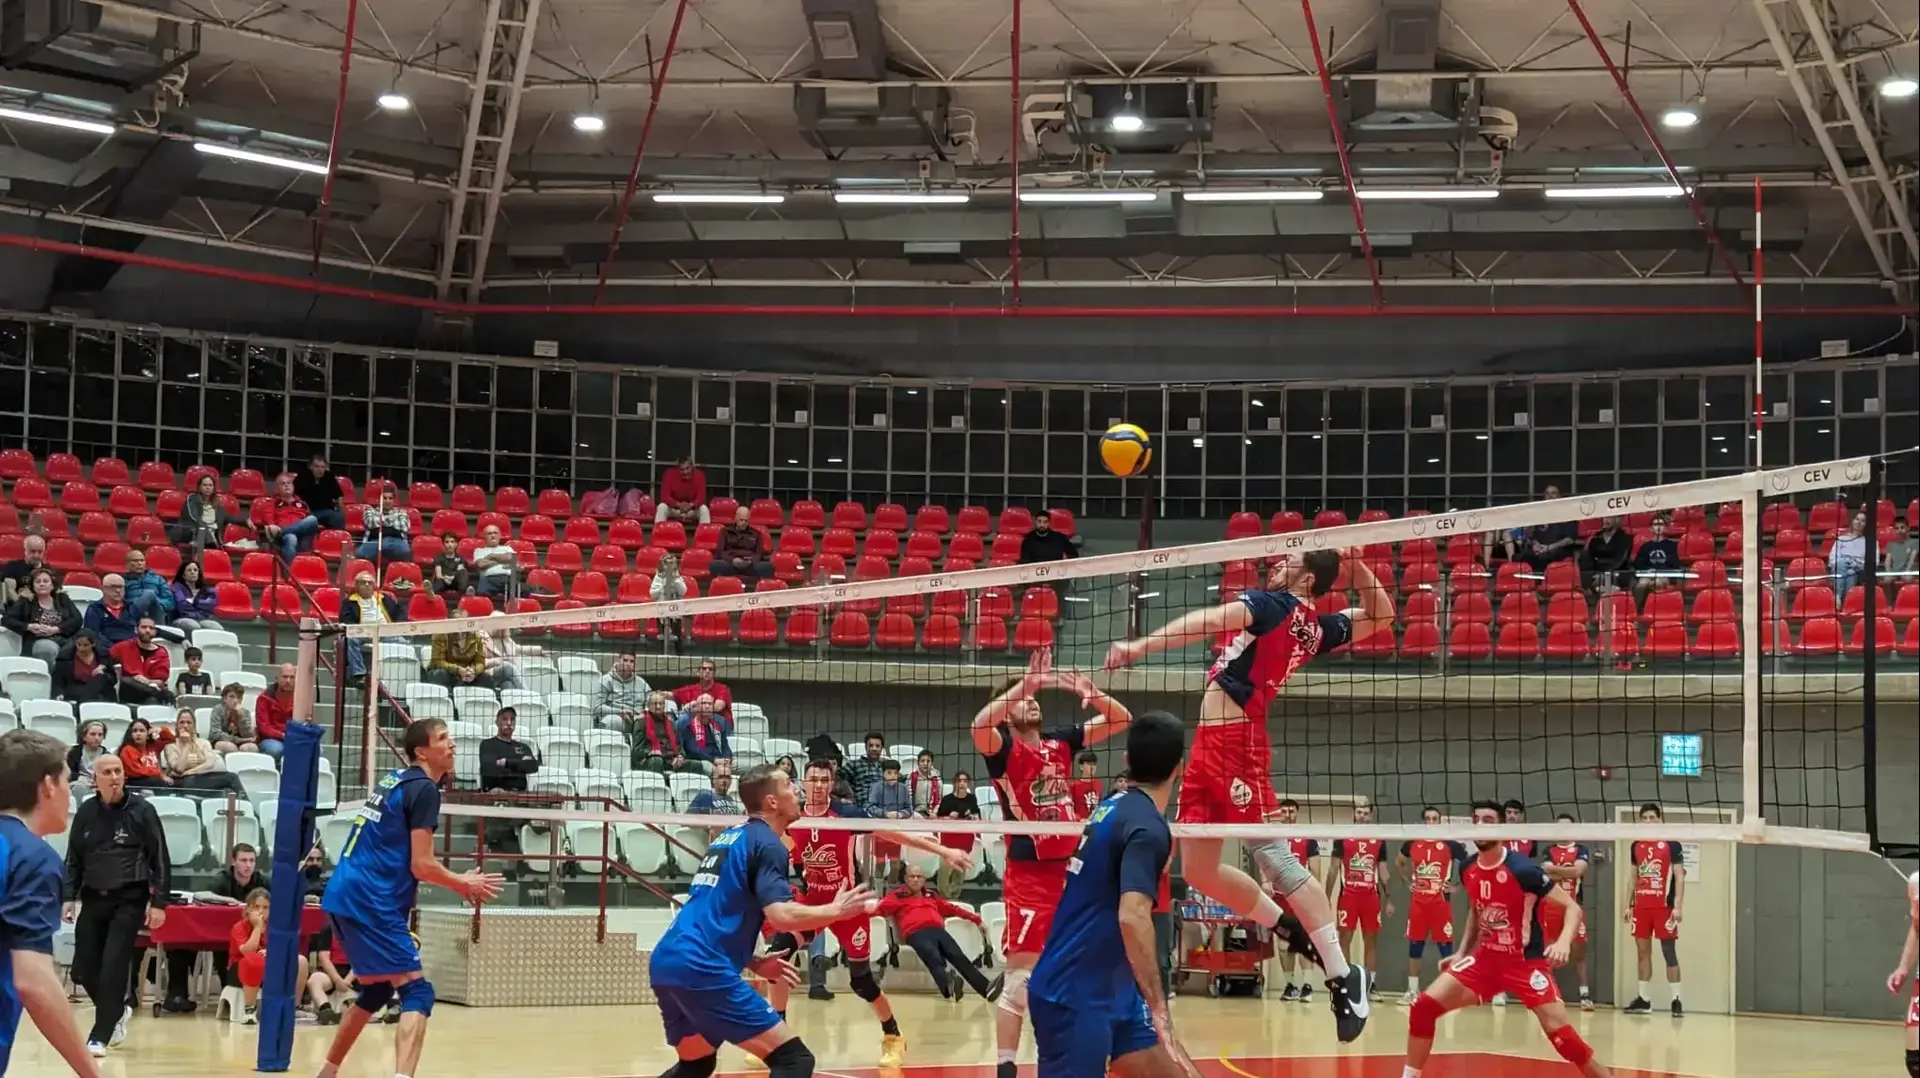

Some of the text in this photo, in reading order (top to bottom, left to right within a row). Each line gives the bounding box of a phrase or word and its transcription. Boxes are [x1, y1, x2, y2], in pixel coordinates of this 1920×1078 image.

[1803, 468, 1831, 483] CEV
[1607, 496, 1632, 510] CEV
[1436, 518, 1457, 531] CEV
[1285, 536, 1304, 548] CEV
[1152, 553, 1170, 564] CEV
[1035, 566, 1050, 577] CEV
[929, 578, 943, 588] CEV
[834, 588, 847, 597] CEV
[1358, 841, 1367, 853] 12
[1647, 846, 1654, 859] 5
[1427, 849, 1431, 861] 1
[1479, 880, 1491, 900] 10
[1018, 908, 1036, 944] 7
